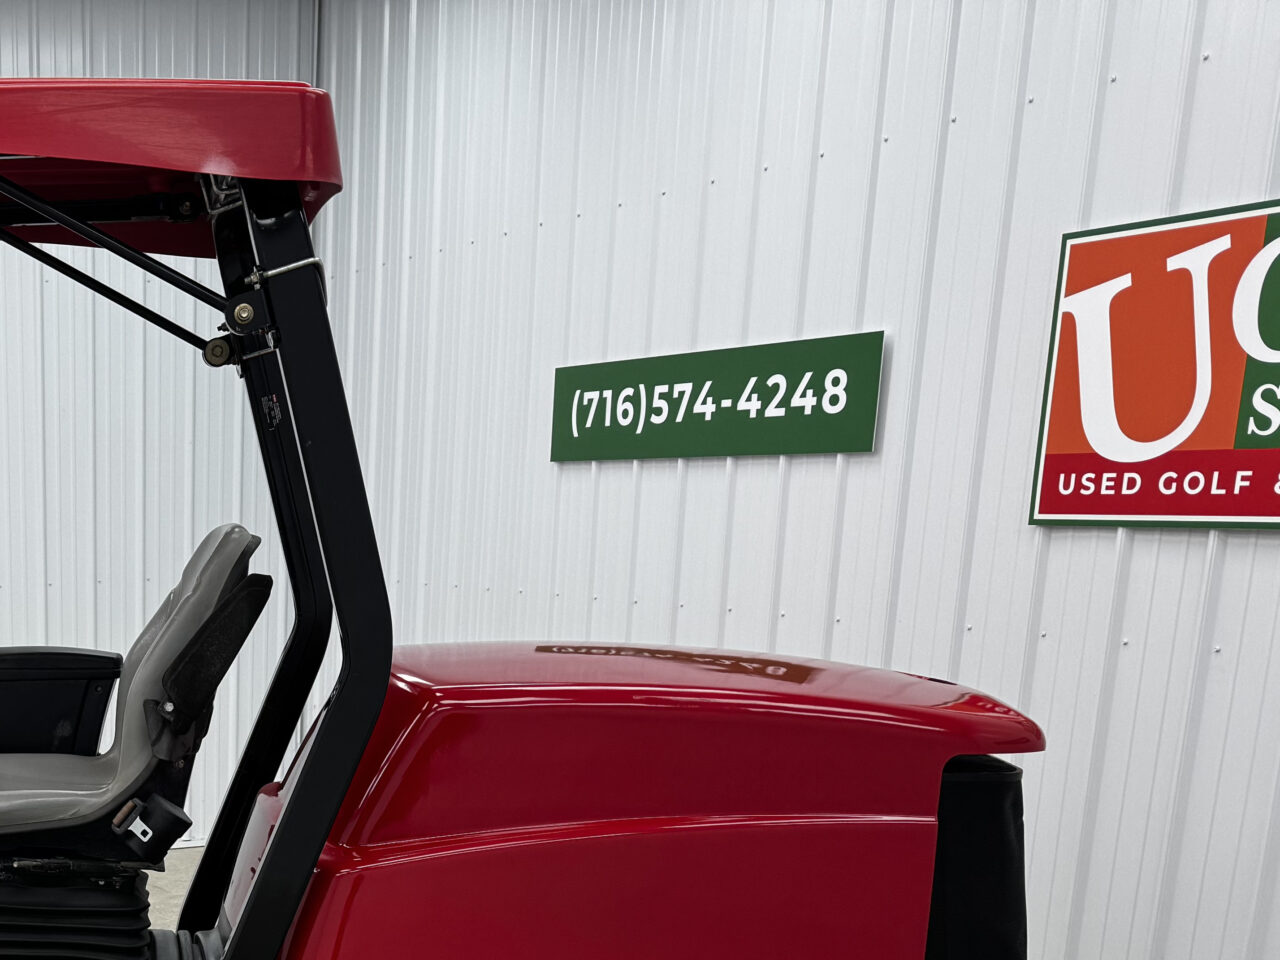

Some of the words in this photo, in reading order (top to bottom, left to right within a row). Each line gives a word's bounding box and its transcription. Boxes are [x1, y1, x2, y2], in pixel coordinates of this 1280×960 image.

[571, 369, 848, 437] (716)574-4248
[1058, 472, 1142, 495] USED
[1158, 470, 1253, 495] GOLF
